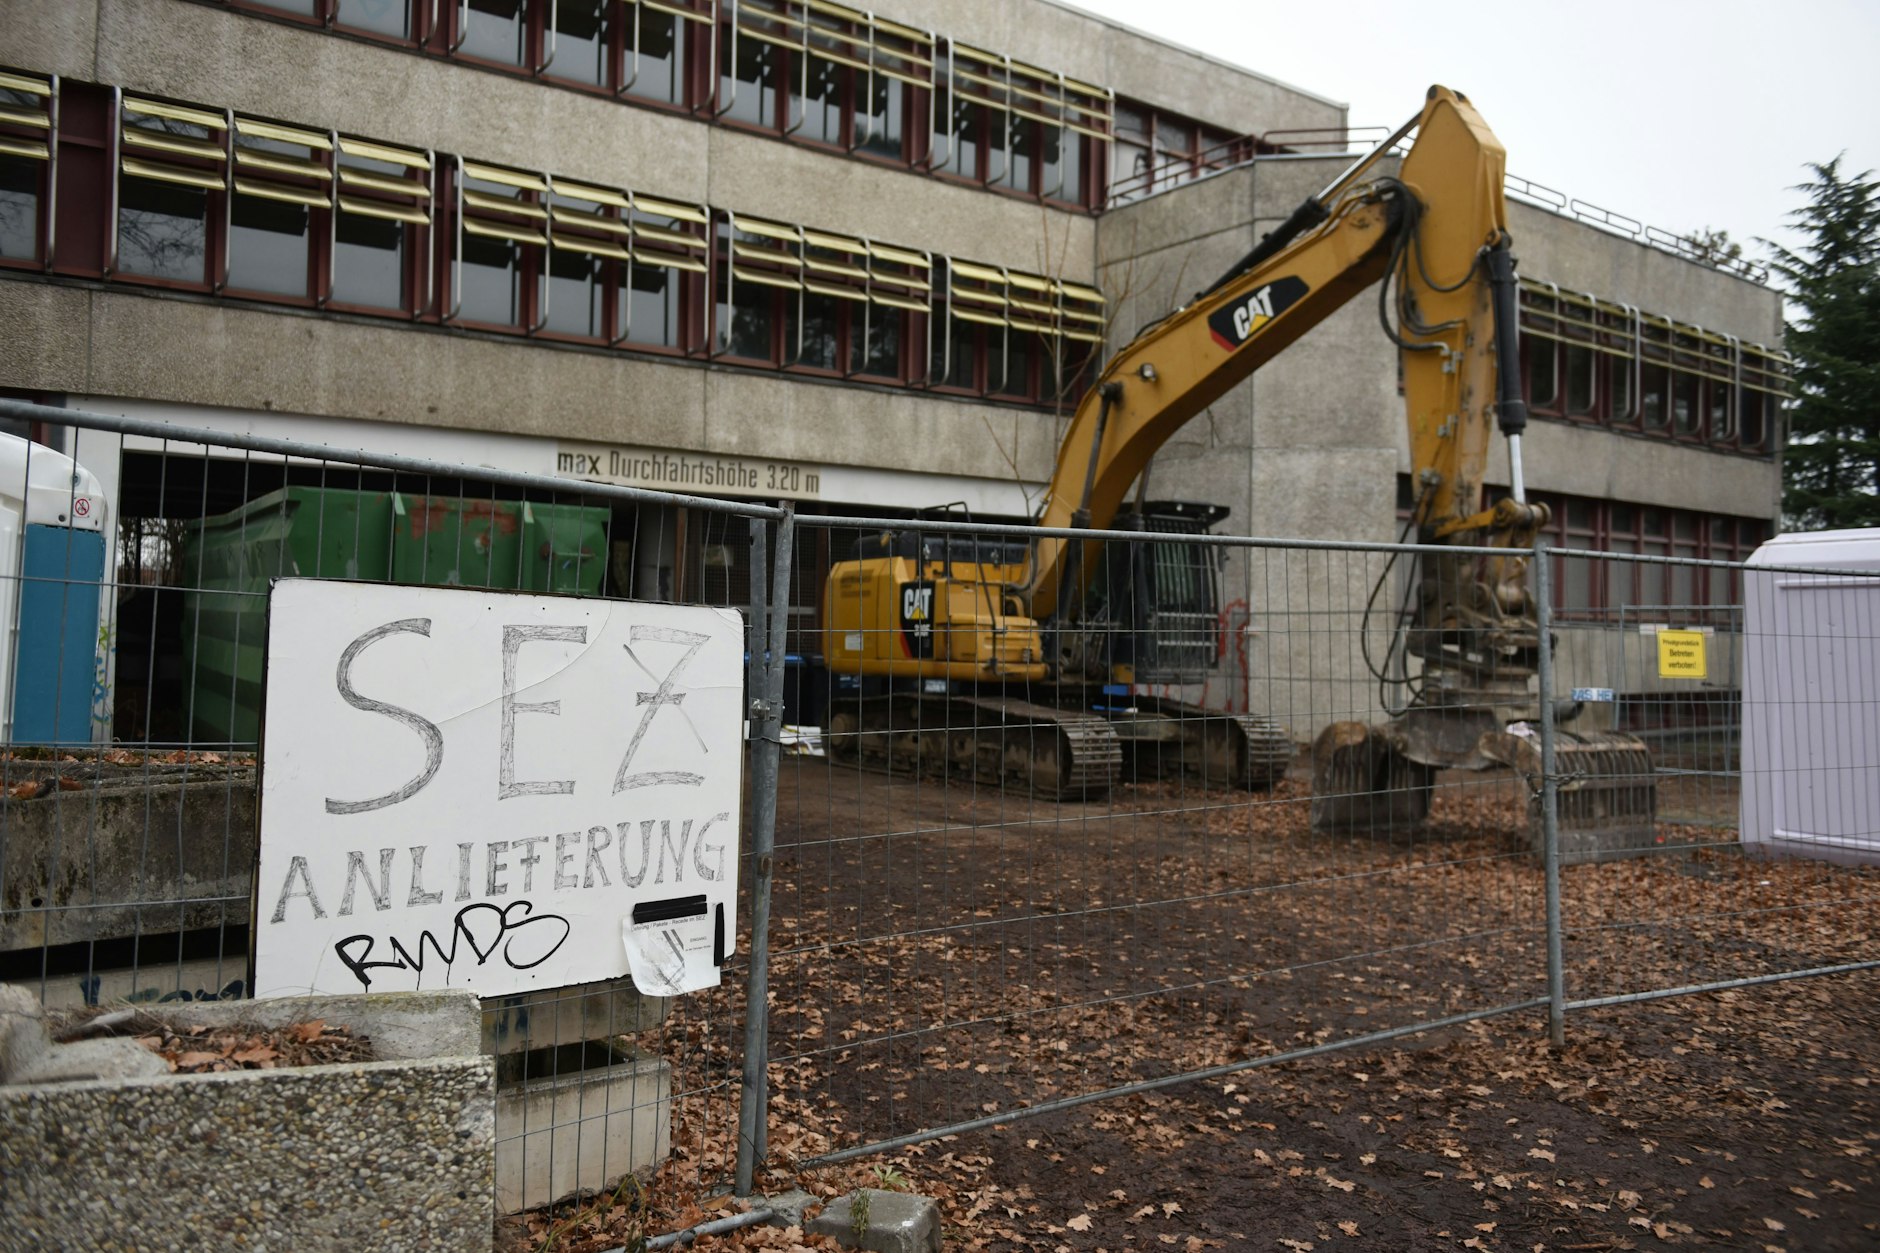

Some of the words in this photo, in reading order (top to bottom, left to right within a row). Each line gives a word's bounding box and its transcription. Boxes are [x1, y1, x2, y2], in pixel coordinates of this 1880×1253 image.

[1233, 285, 1274, 340] CAT
[557, 451, 601, 476] max
[609, 450, 757, 488] Durchfahrtshöhe
[767, 464, 799, 492] 3.20
[805, 473, 820, 494] m
[903, 588, 932, 620] CAT
[1669, 648, 1695, 657] Betreten
[325, 617, 712, 815] SEZ
[270, 811, 730, 924] ANLIEFERUNG
